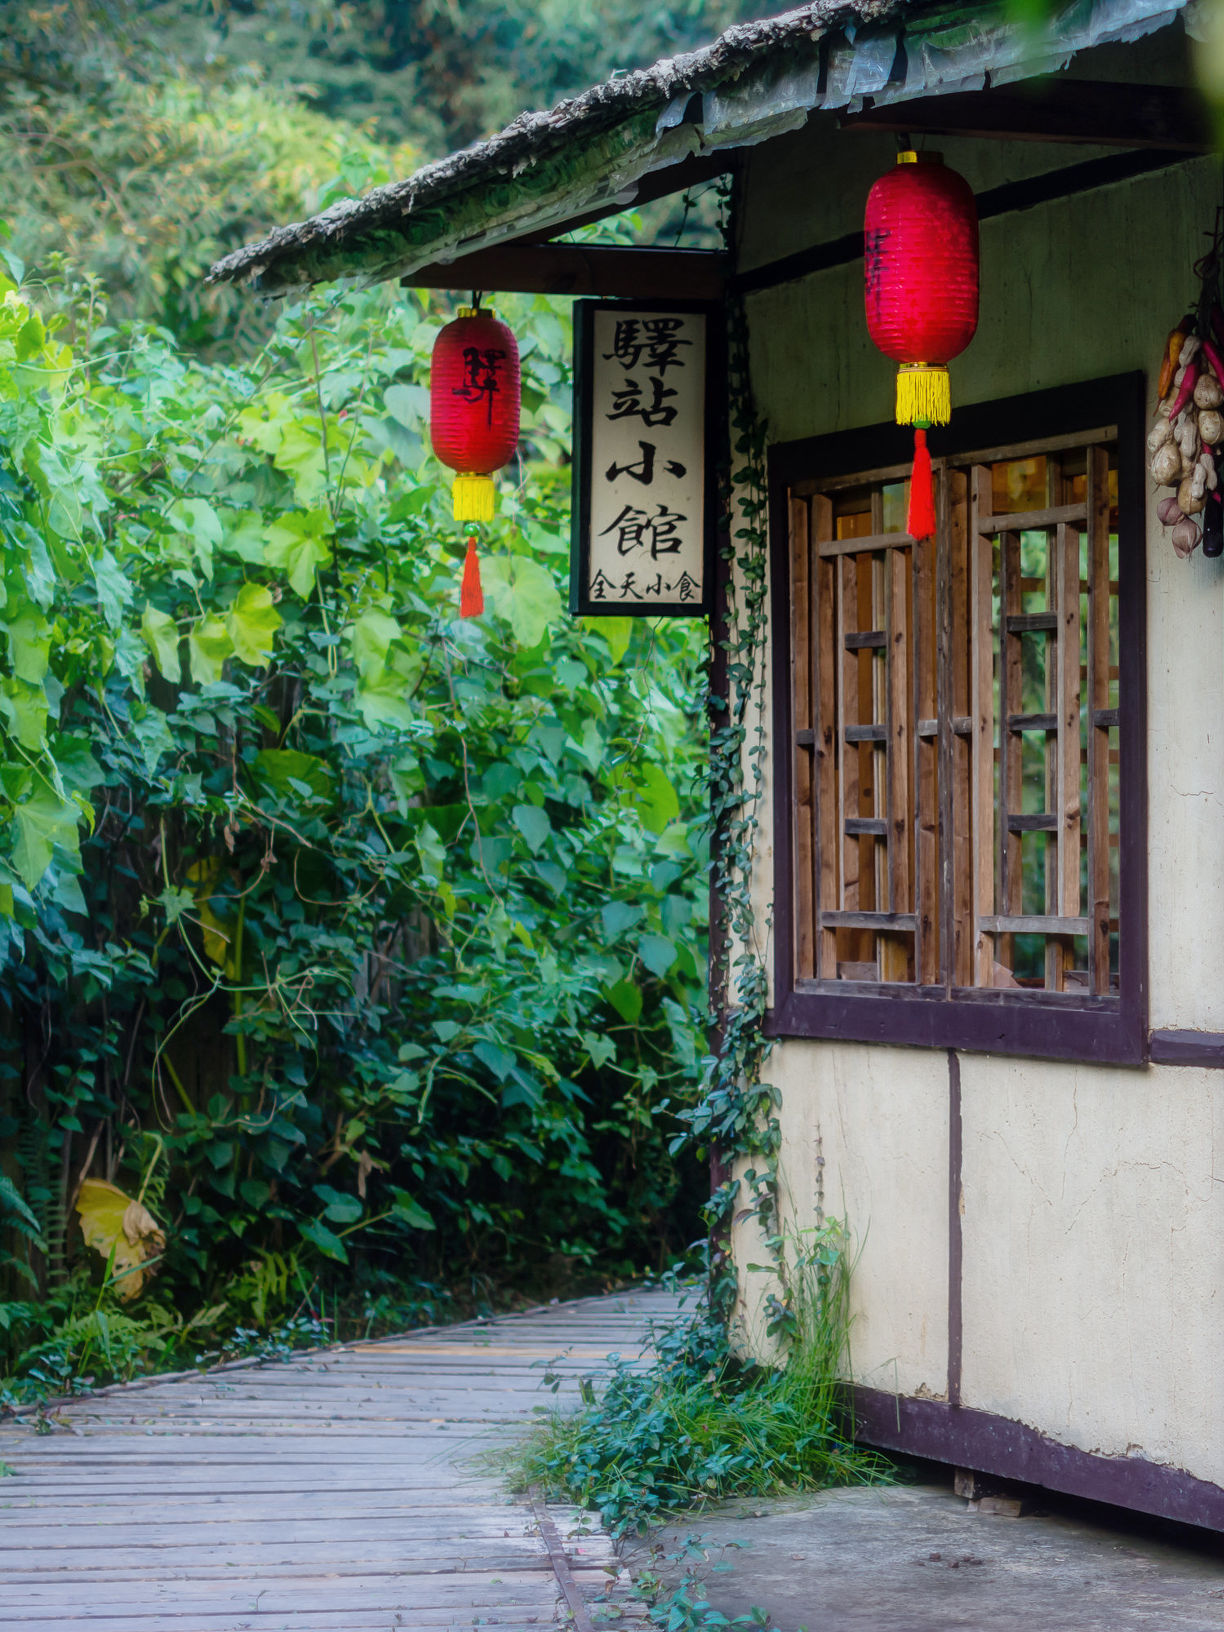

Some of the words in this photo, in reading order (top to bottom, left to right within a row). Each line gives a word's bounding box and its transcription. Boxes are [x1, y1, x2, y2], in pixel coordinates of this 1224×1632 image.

[598, 318, 693, 561] 驛站小館
[589, 568, 702, 602] 全天小食
